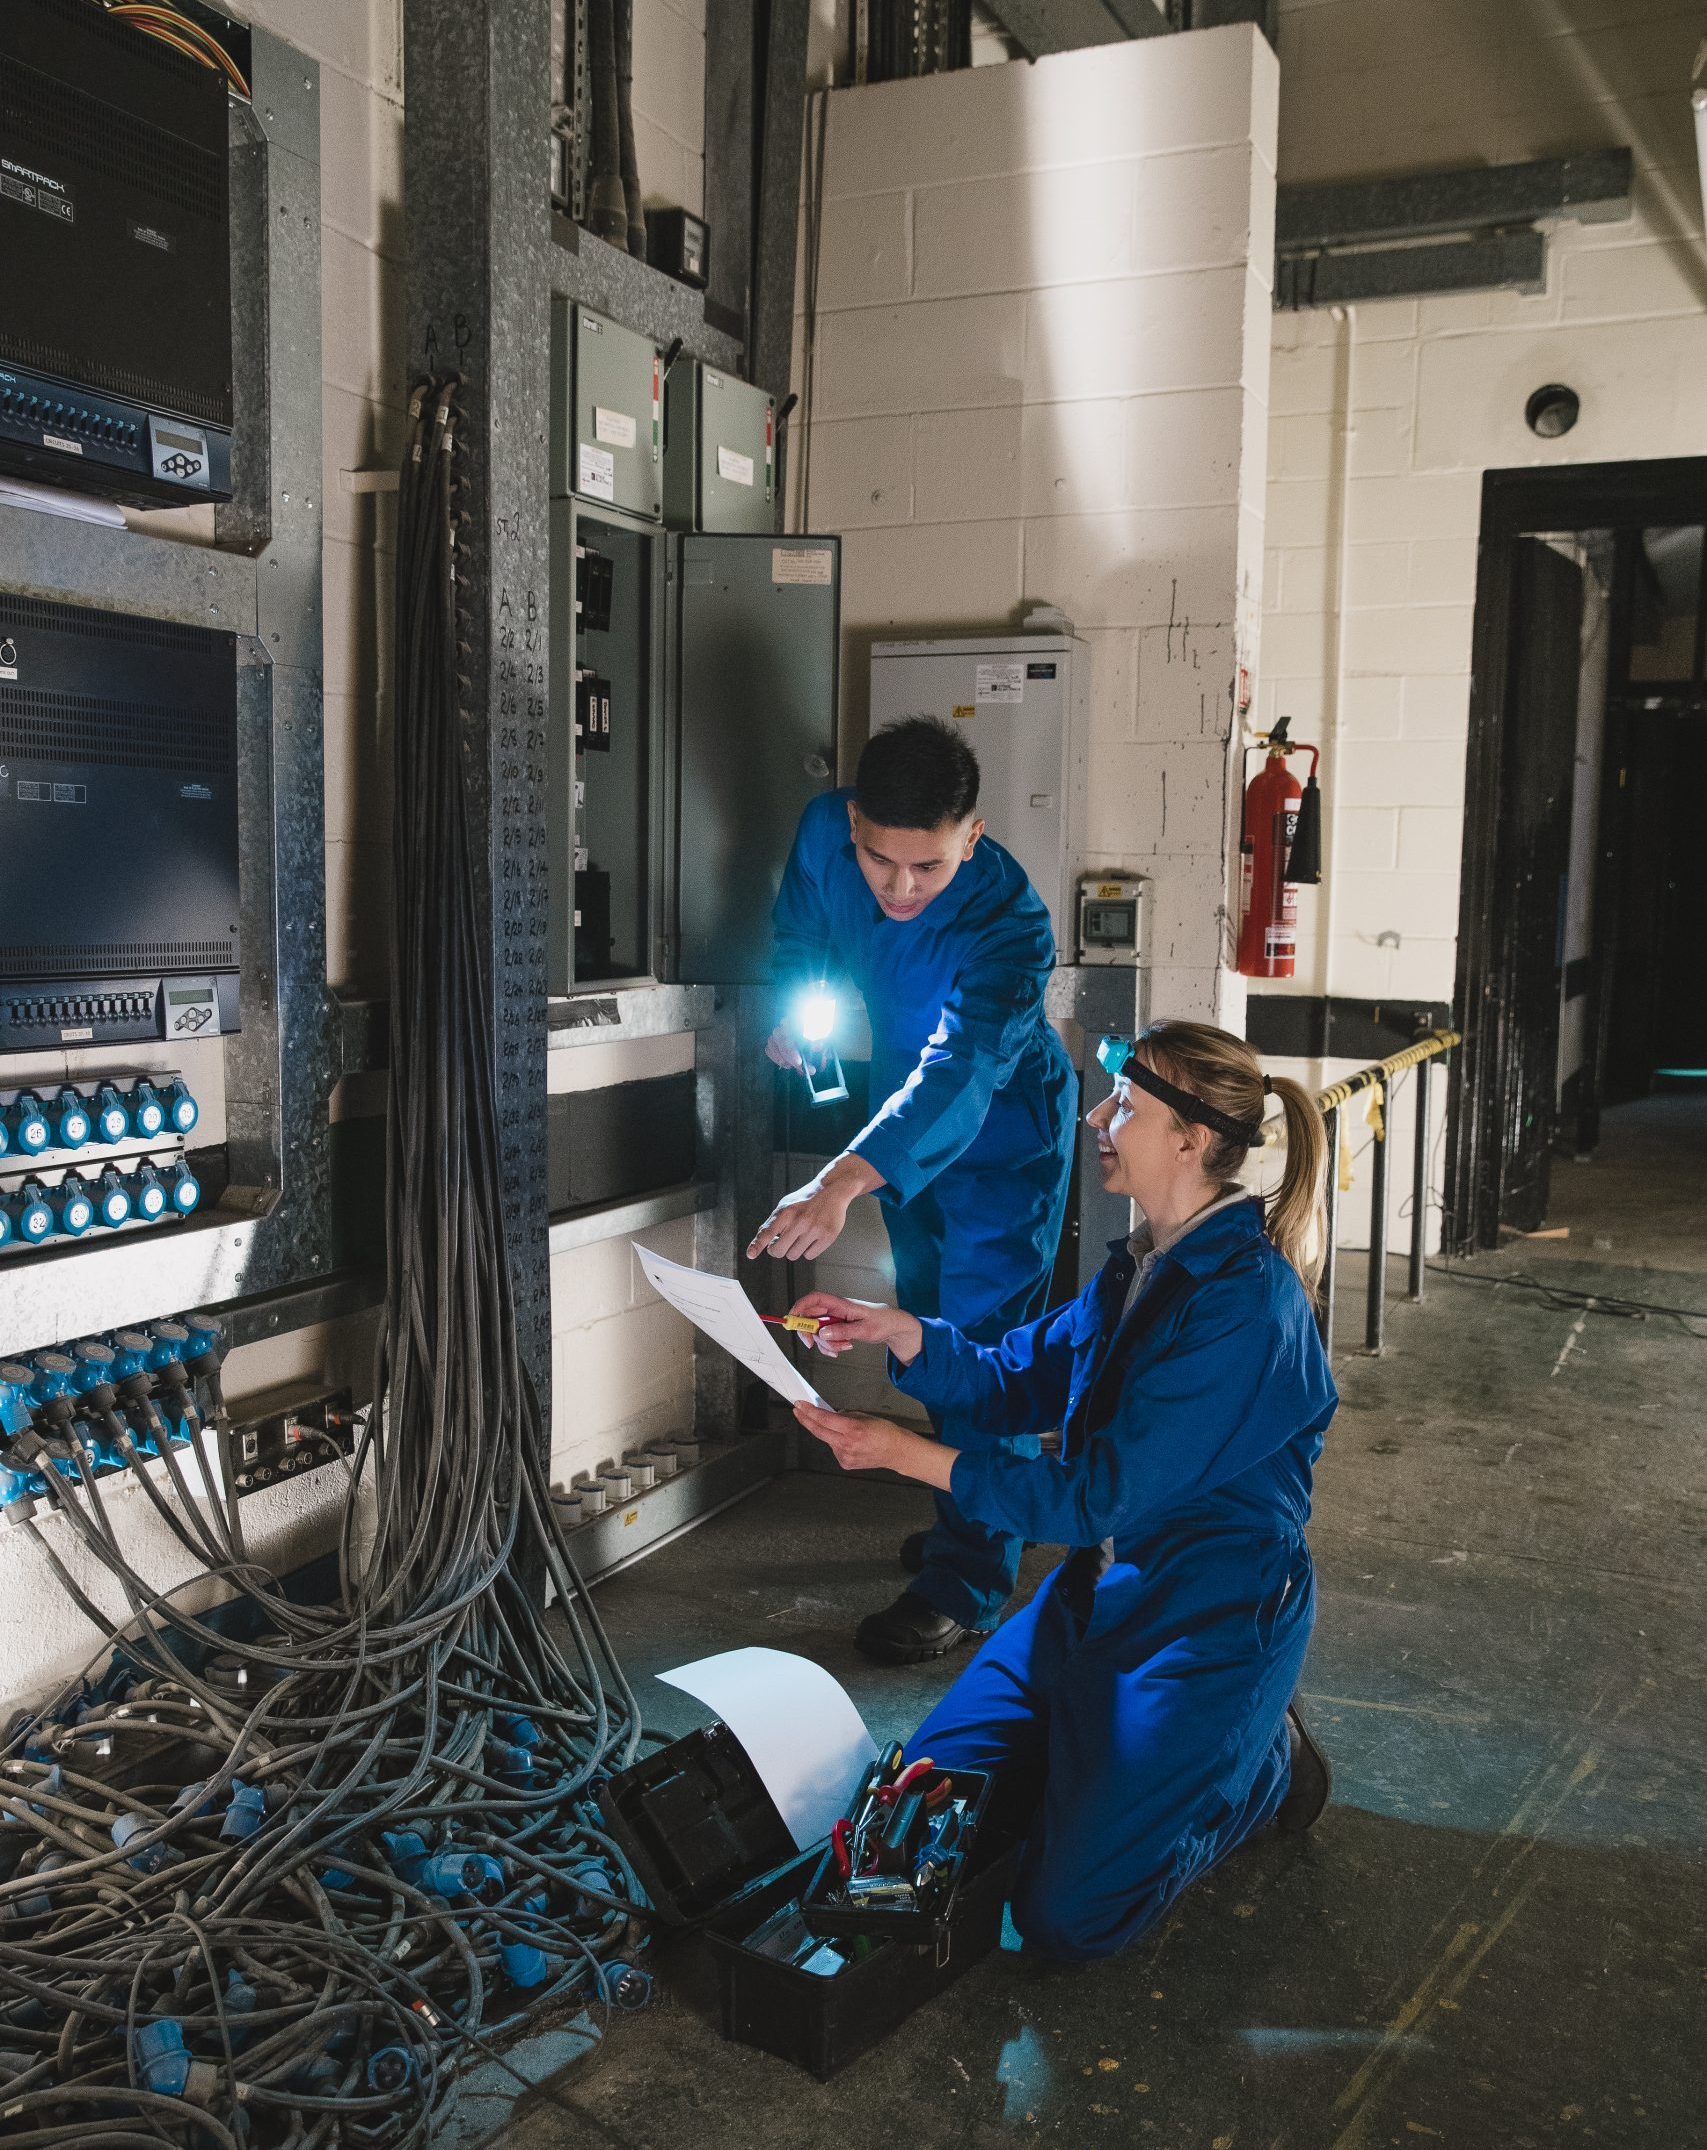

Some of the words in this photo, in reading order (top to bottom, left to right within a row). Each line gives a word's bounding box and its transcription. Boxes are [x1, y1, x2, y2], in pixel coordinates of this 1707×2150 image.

[1, 159, 65, 193] SMARTPACK
[454, 313, 472, 348] B
[499, 586, 512, 618] A
[528, 590, 536, 622] B
[526, 663, 543, 685] 2/3
[527, 696, 543, 718] 2/5
[30, 1127, 42, 1140] 26
[33, 1216, 46, 1229] 32
